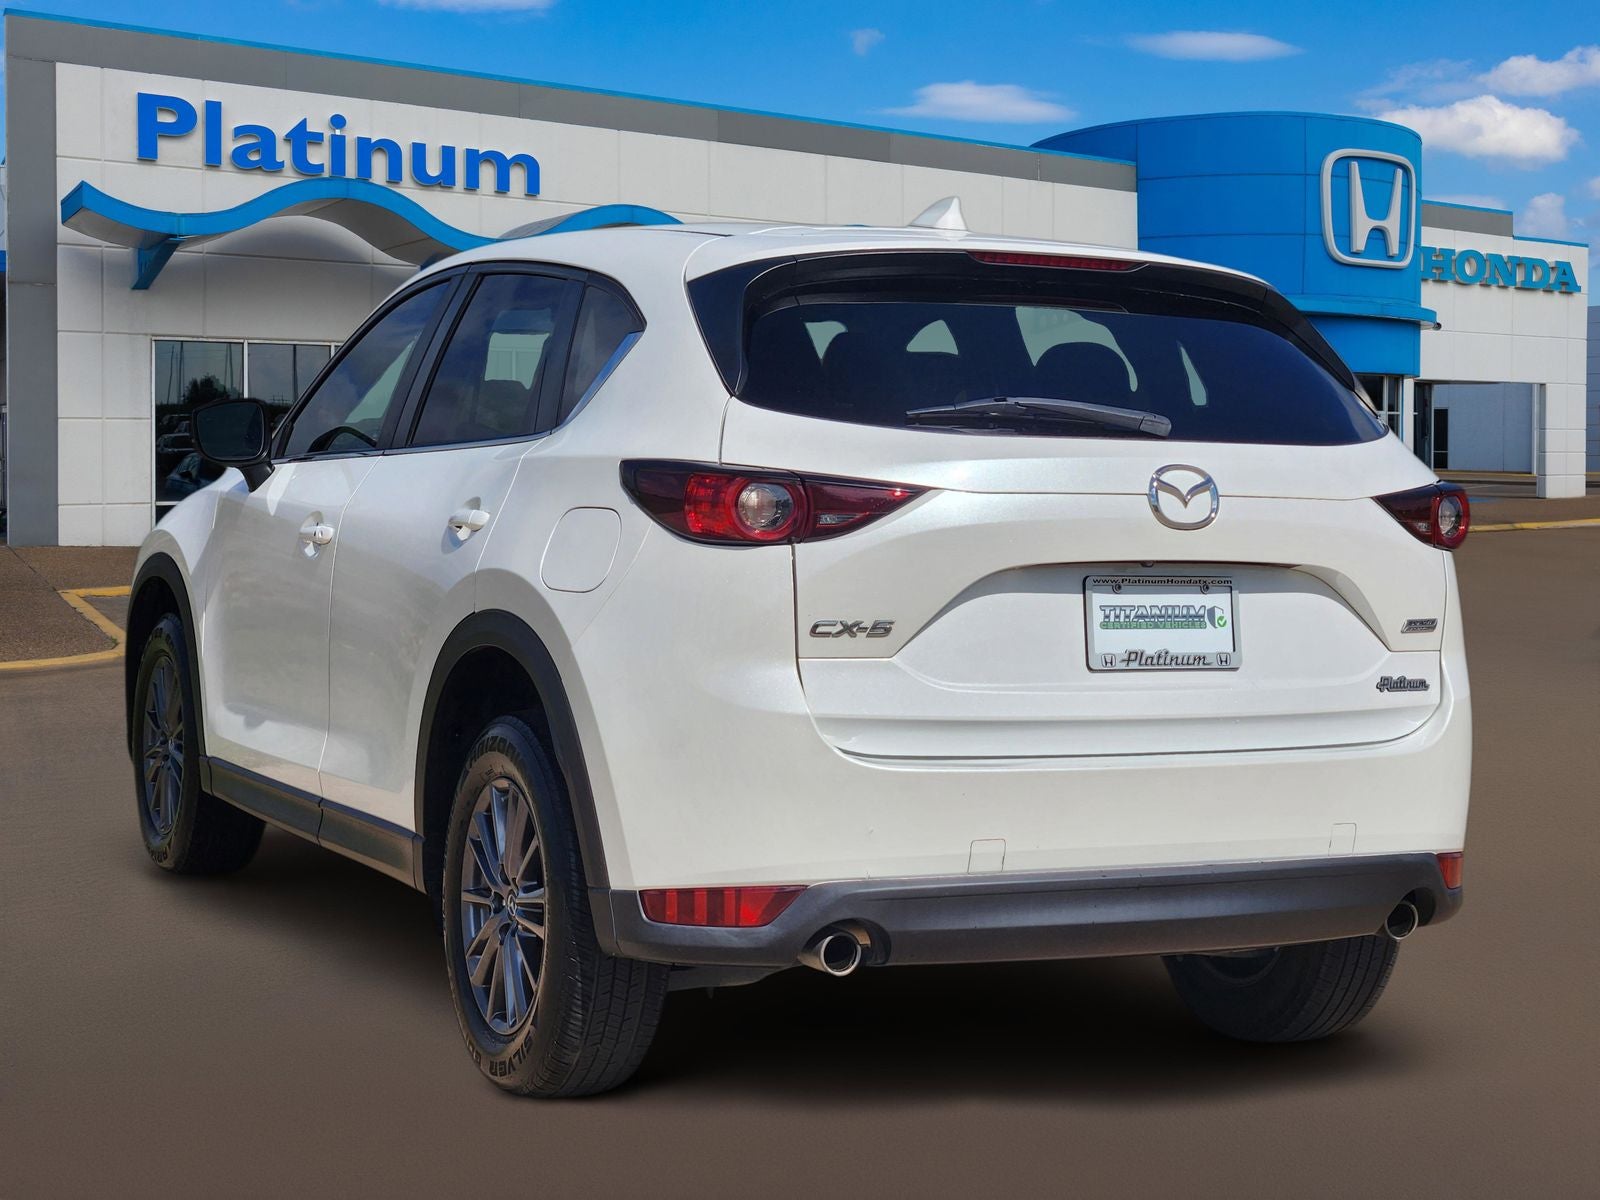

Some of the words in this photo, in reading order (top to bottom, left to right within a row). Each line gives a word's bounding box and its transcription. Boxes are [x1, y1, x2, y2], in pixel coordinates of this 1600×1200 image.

[137, 92, 540, 196] Platinum
[1421, 246, 1581, 293] HONDA
[1099, 605, 1207, 622] TITANIUM
[809, 620, 895, 638] CX-5
[1100, 621, 1154, 629] CERTIFIED
[1159, 621, 1207, 629] VEHICLES
[1120, 649, 1213, 667] Platinum
[1376, 676, 1430, 692] Platinum
